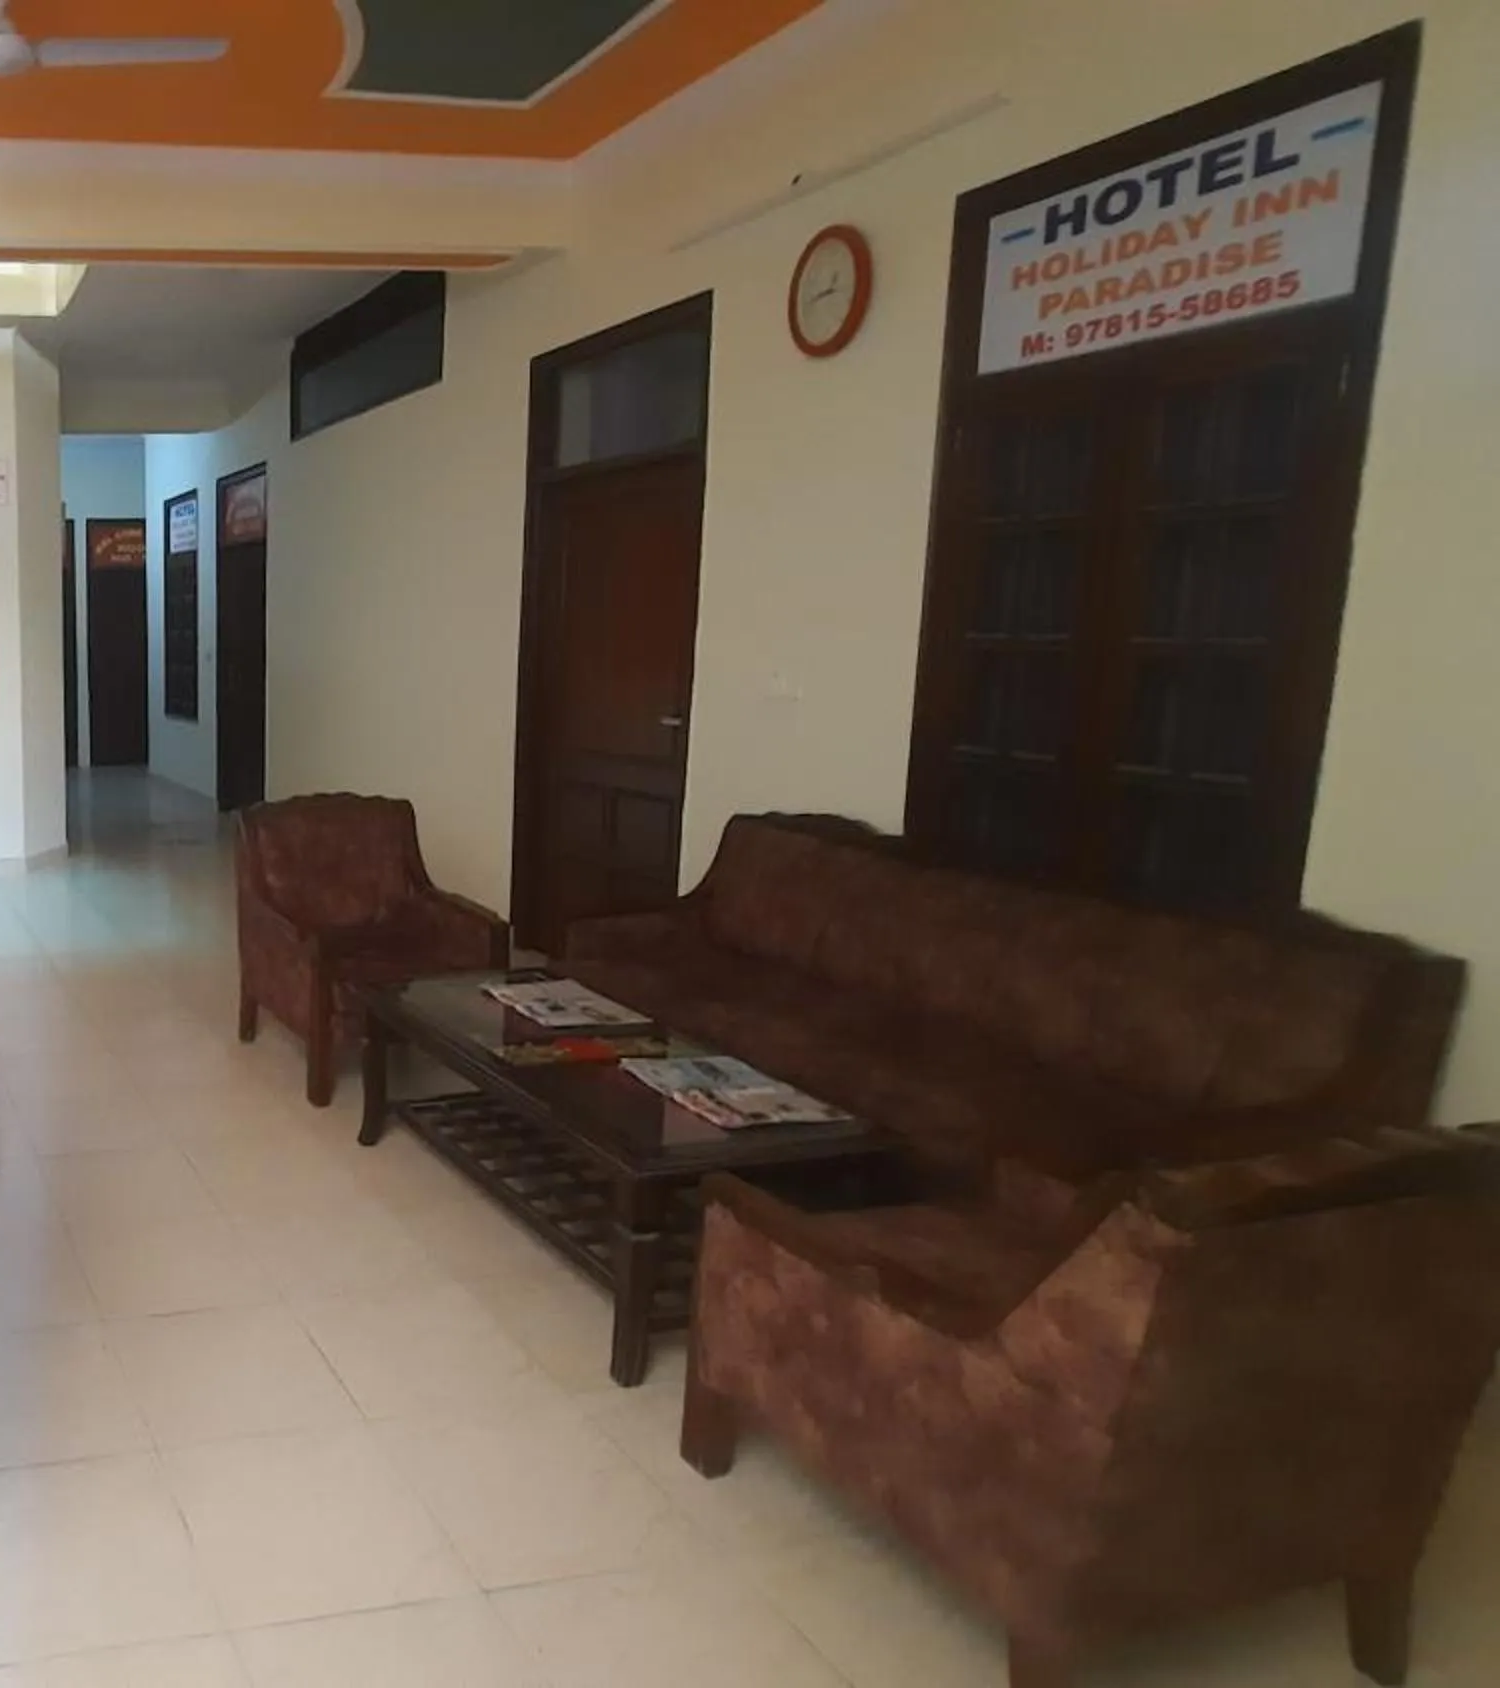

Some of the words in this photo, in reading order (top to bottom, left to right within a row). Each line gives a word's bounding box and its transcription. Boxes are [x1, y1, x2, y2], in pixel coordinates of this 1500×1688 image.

[1010, 207, 1213, 291] HOLIDAY
[1231, 169, 1340, 228] INN
[1043, 129, 1300, 243] HOTEL
[1038, 230, 1284, 321] PARADISE
[1064, 270, 1301, 347] 97815-58685
